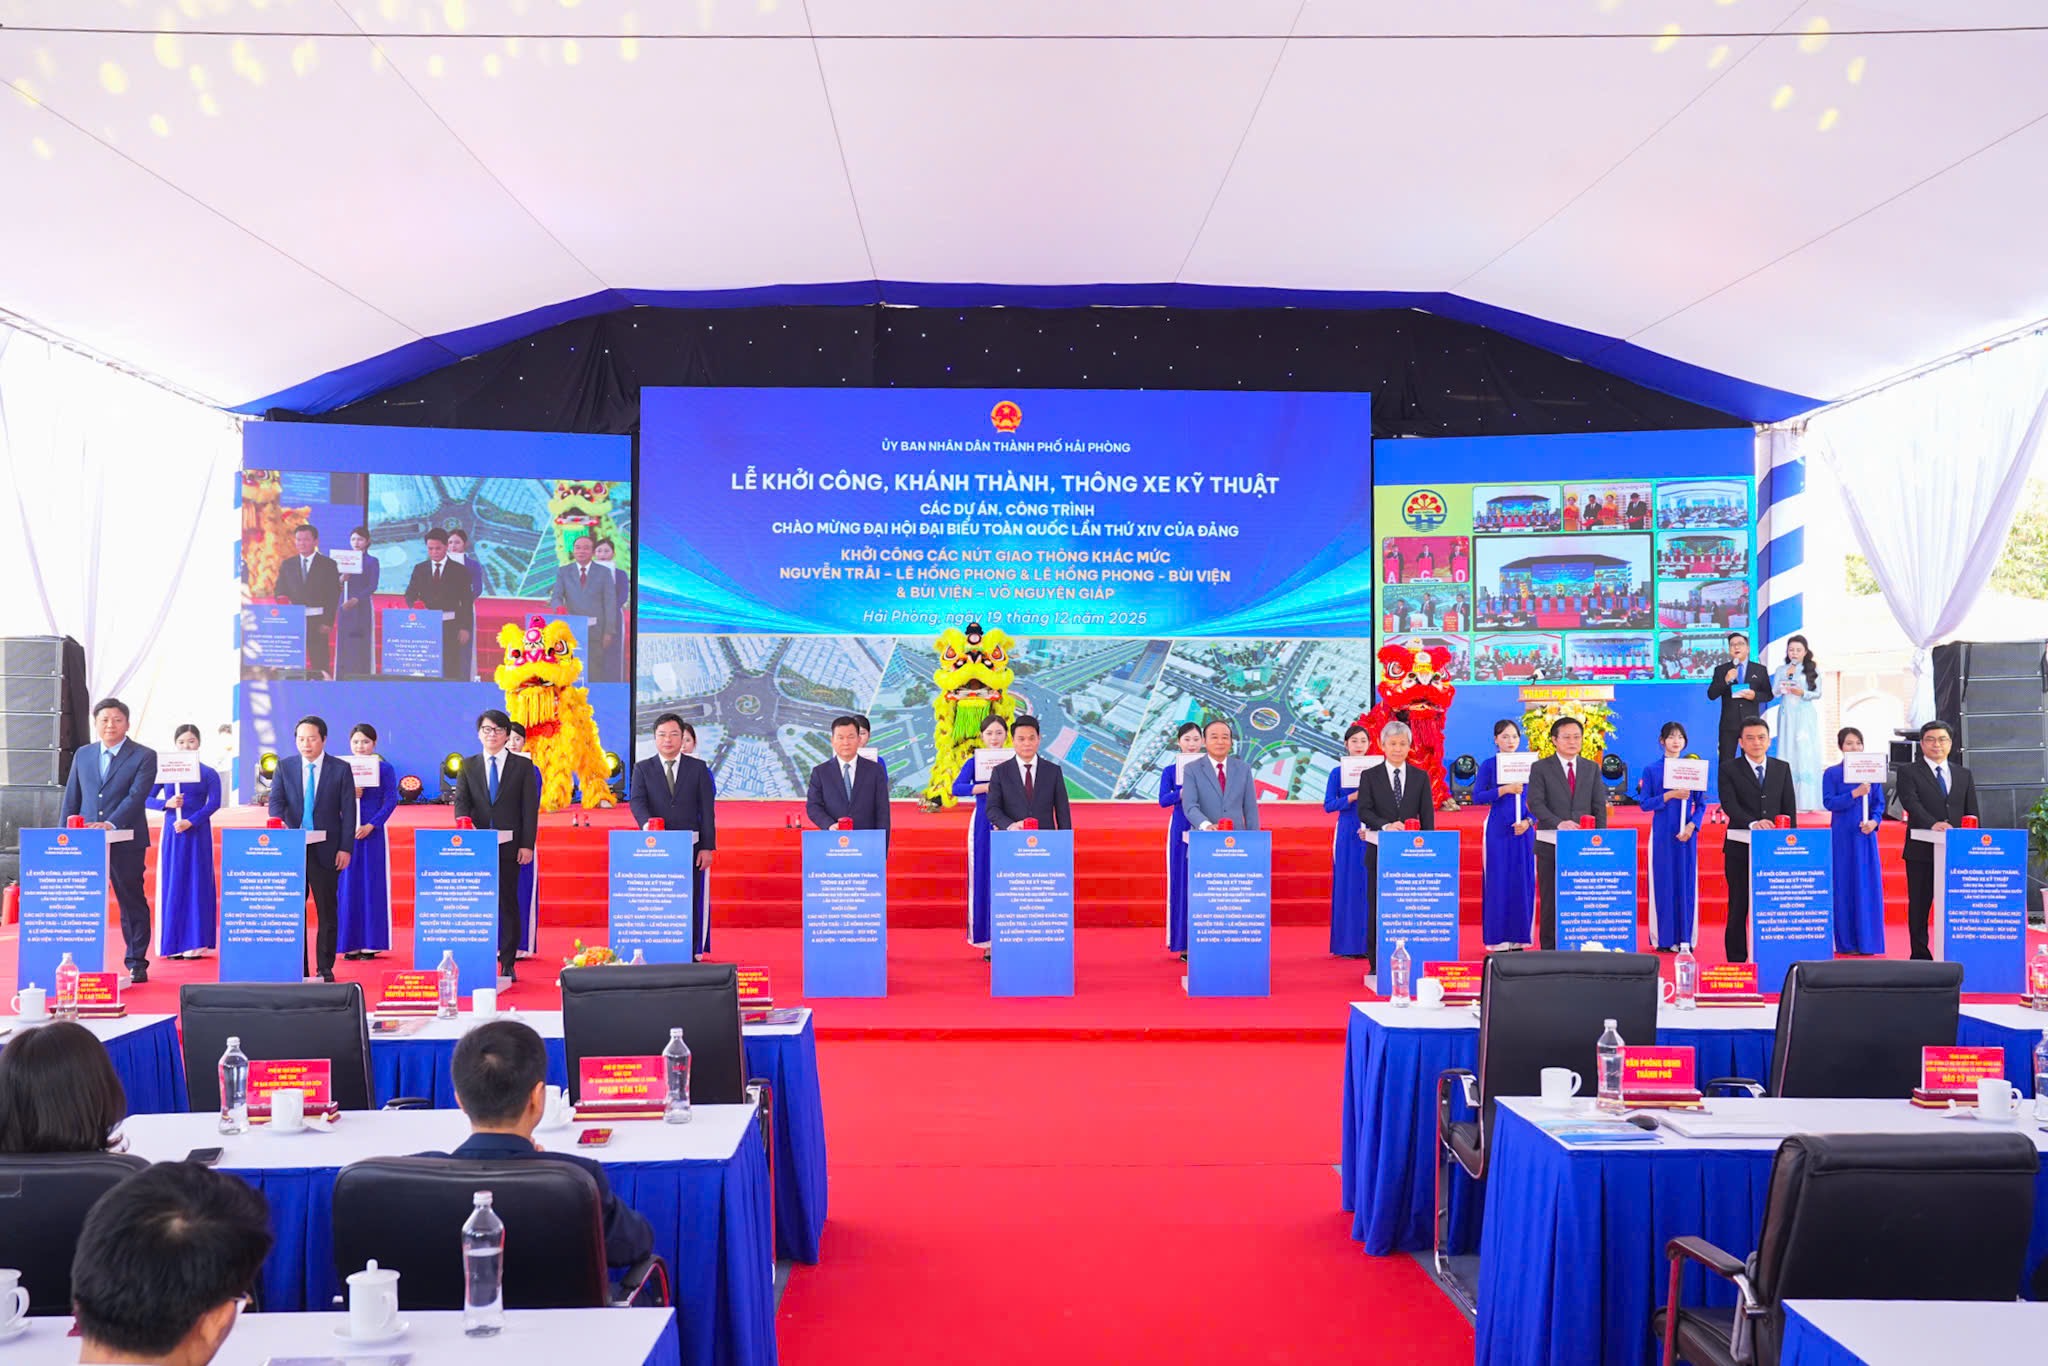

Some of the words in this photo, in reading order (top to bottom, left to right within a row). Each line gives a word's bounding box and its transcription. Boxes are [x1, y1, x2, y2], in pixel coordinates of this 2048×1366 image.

[900, 441, 926, 451] BAN
[928, 439, 962, 451] NHÂN
[964, 440, 990, 451] DÂN
[992, 440, 1034, 452] THÀNH
[1037, 438, 1062, 452] PHỐ
[1064, 439, 1085, 452] HẢI
[1087, 440, 1130, 452] PHÒNG
[731, 466, 757, 490] LỄ
[762, 468, 814, 491] KHỞI
[818, 470, 888, 493] CÔNG,
[894, 470, 968, 491] KHÁNH
[974, 470, 1054, 493] THÀNH,
[1061, 471, 1137, 492] THÔNG
[1142, 475, 1170, 492] XE
[1176, 472, 1204, 493] KỸ
[1209, 472, 1279, 497] THUẬT
[919, 501, 951, 516] CÁC
[976, 500, 1002, 517] ÁN,
[1005, 501, 1049, 516] CÔNG
[1051, 501, 1094, 516] TRÌNH
[771, 520, 814, 535] CHÀO
[816, 519, 861, 535] MỪNG
[862, 522, 888, 538] ĐẠI
[890, 520, 917, 538] HỘI
[918, 522, 944, 538] ĐẠI
[946, 516, 980, 535] BIỂU
[982, 519, 1023, 535] TOÀN
[1025, 519, 1070, 536] QUỐC
[1071, 519, 1102, 536] LẦN
[1103, 520, 1135, 537] THỨ
[1136, 525, 1162, 536] XIV
[1163, 522, 1195, 537] CỦA
[1197, 521, 1239, 537] ĐẢNG
[840, 546, 876, 560] KHỞI
[879, 547, 924, 561] CÔNG
[926, 547, 958, 561] CÁC
[961, 547, 992, 561] NÚT
[995, 551, 1033, 562] GIAO
[1035, 548, 1089, 562] THÔNG
[1091, 549, 1133, 563] KHÁC
[1136, 549, 1170, 563] MỨC
[909, 584, 935, 598] BÙI
[937, 584, 972, 601] VIỆN
[1013, 585, 1075, 599] NGUYÊN
[1078, 585, 1115, 599] GIÁP
[863, 610, 887, 622] Hải
[890, 610, 942, 625] Phòng,
[946, 614, 983, 626] ngày
[986, 611, 1003, 624] 19
[1005, 611, 1050, 626] tháng
[1053, 612, 1069, 624] 12
[1071, 612, 1105, 624] năm
[1107, 612, 1147, 625] 2025
